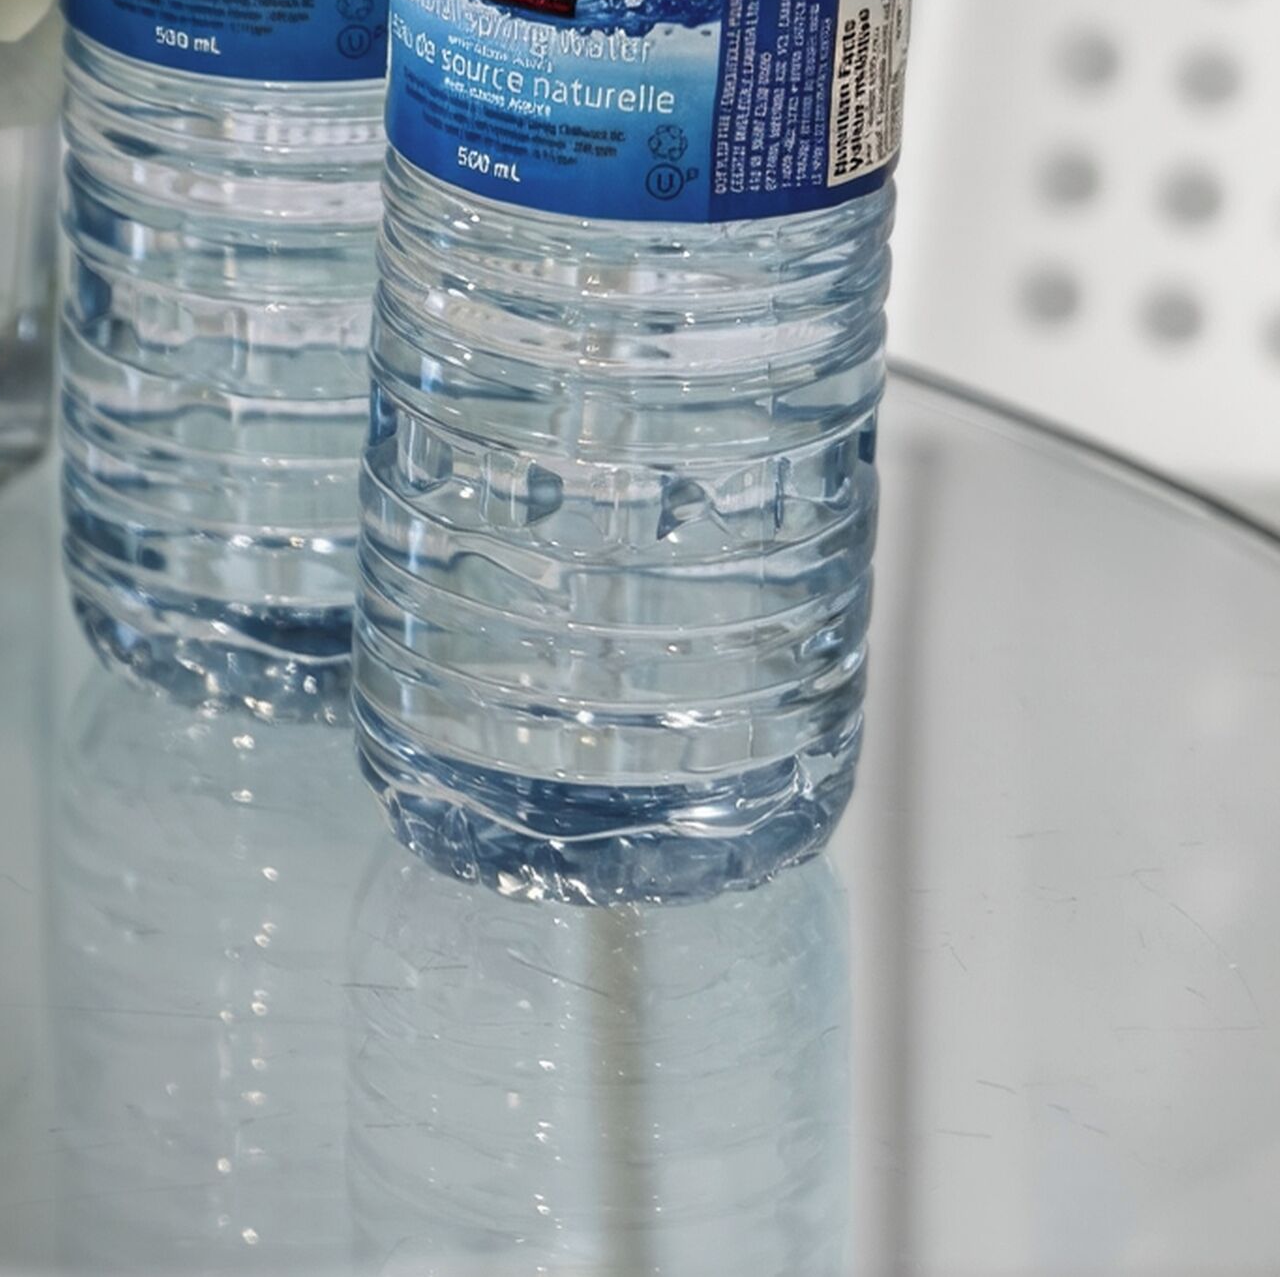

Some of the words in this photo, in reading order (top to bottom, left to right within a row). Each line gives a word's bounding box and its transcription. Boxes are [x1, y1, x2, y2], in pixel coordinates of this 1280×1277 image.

[154, 24, 189, 51] 500
[192, 35, 223, 55] mL
[415, 30, 437, 65] de
[440, 48, 524, 94] source
[533, 74, 675, 115] naturelle
[456, 145, 491, 174] 500
[493, 162, 522, 183] mL
